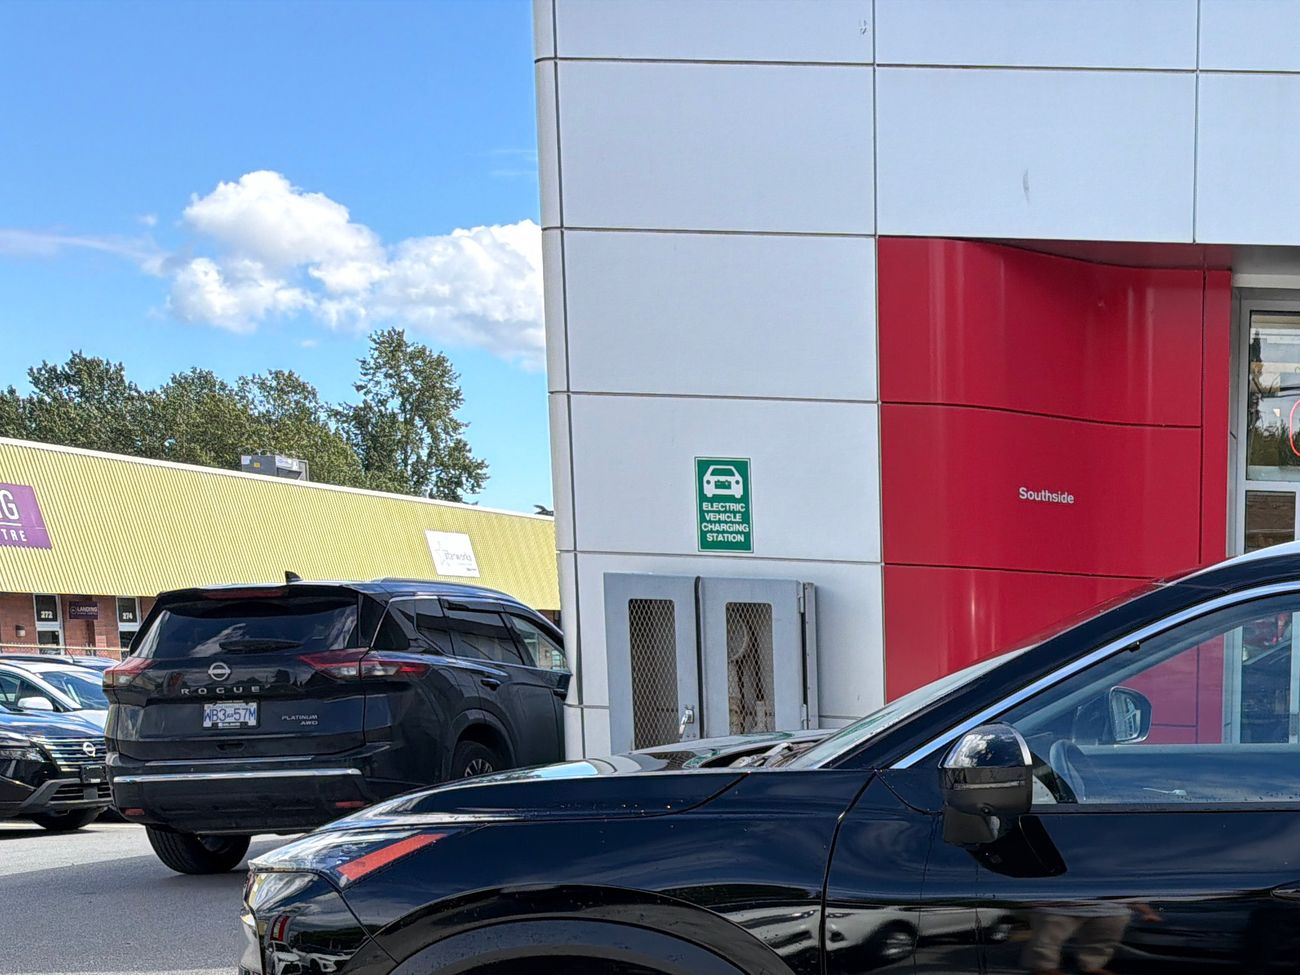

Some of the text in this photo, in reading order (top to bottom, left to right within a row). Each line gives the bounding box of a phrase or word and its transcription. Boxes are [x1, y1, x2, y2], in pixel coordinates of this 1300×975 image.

[1019, 486, 1075, 504] Southside
[702, 502, 746, 512] ELECTRIC
[704, 512, 743, 522] VEHICLE
[701, 522, 749, 532] CHARGING
[706, 532, 745, 542] STATION
[41, 610, 53, 619] 272
[122, 612, 133, 620] 274
[181, 685, 260, 696] ROGUE
